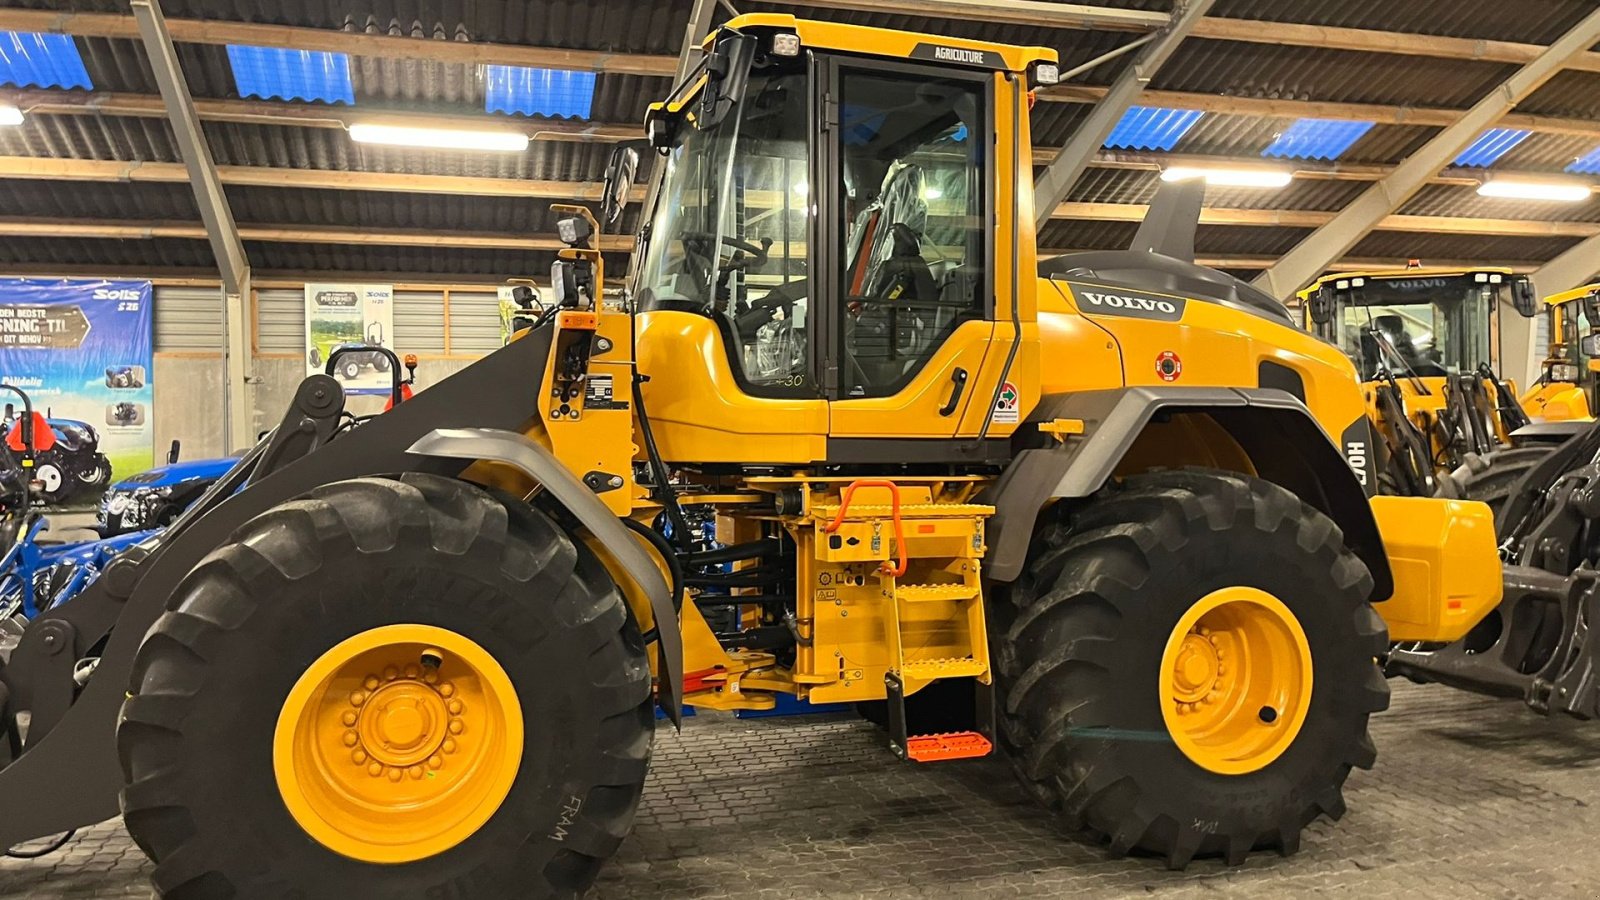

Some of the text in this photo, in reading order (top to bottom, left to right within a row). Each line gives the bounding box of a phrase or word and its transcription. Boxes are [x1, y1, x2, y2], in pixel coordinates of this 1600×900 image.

[935, 47, 984, 64] AGRICULTURE
[1387, 280, 1447, 289] VOLVO
[93, 289, 140, 300] Solis
[1081, 291, 1176, 314] VOLVO
[17, 309, 46, 318] BEDSTE
[47, 319, 70, 332] TIL
[547, 795, 581, 841] FRAM
